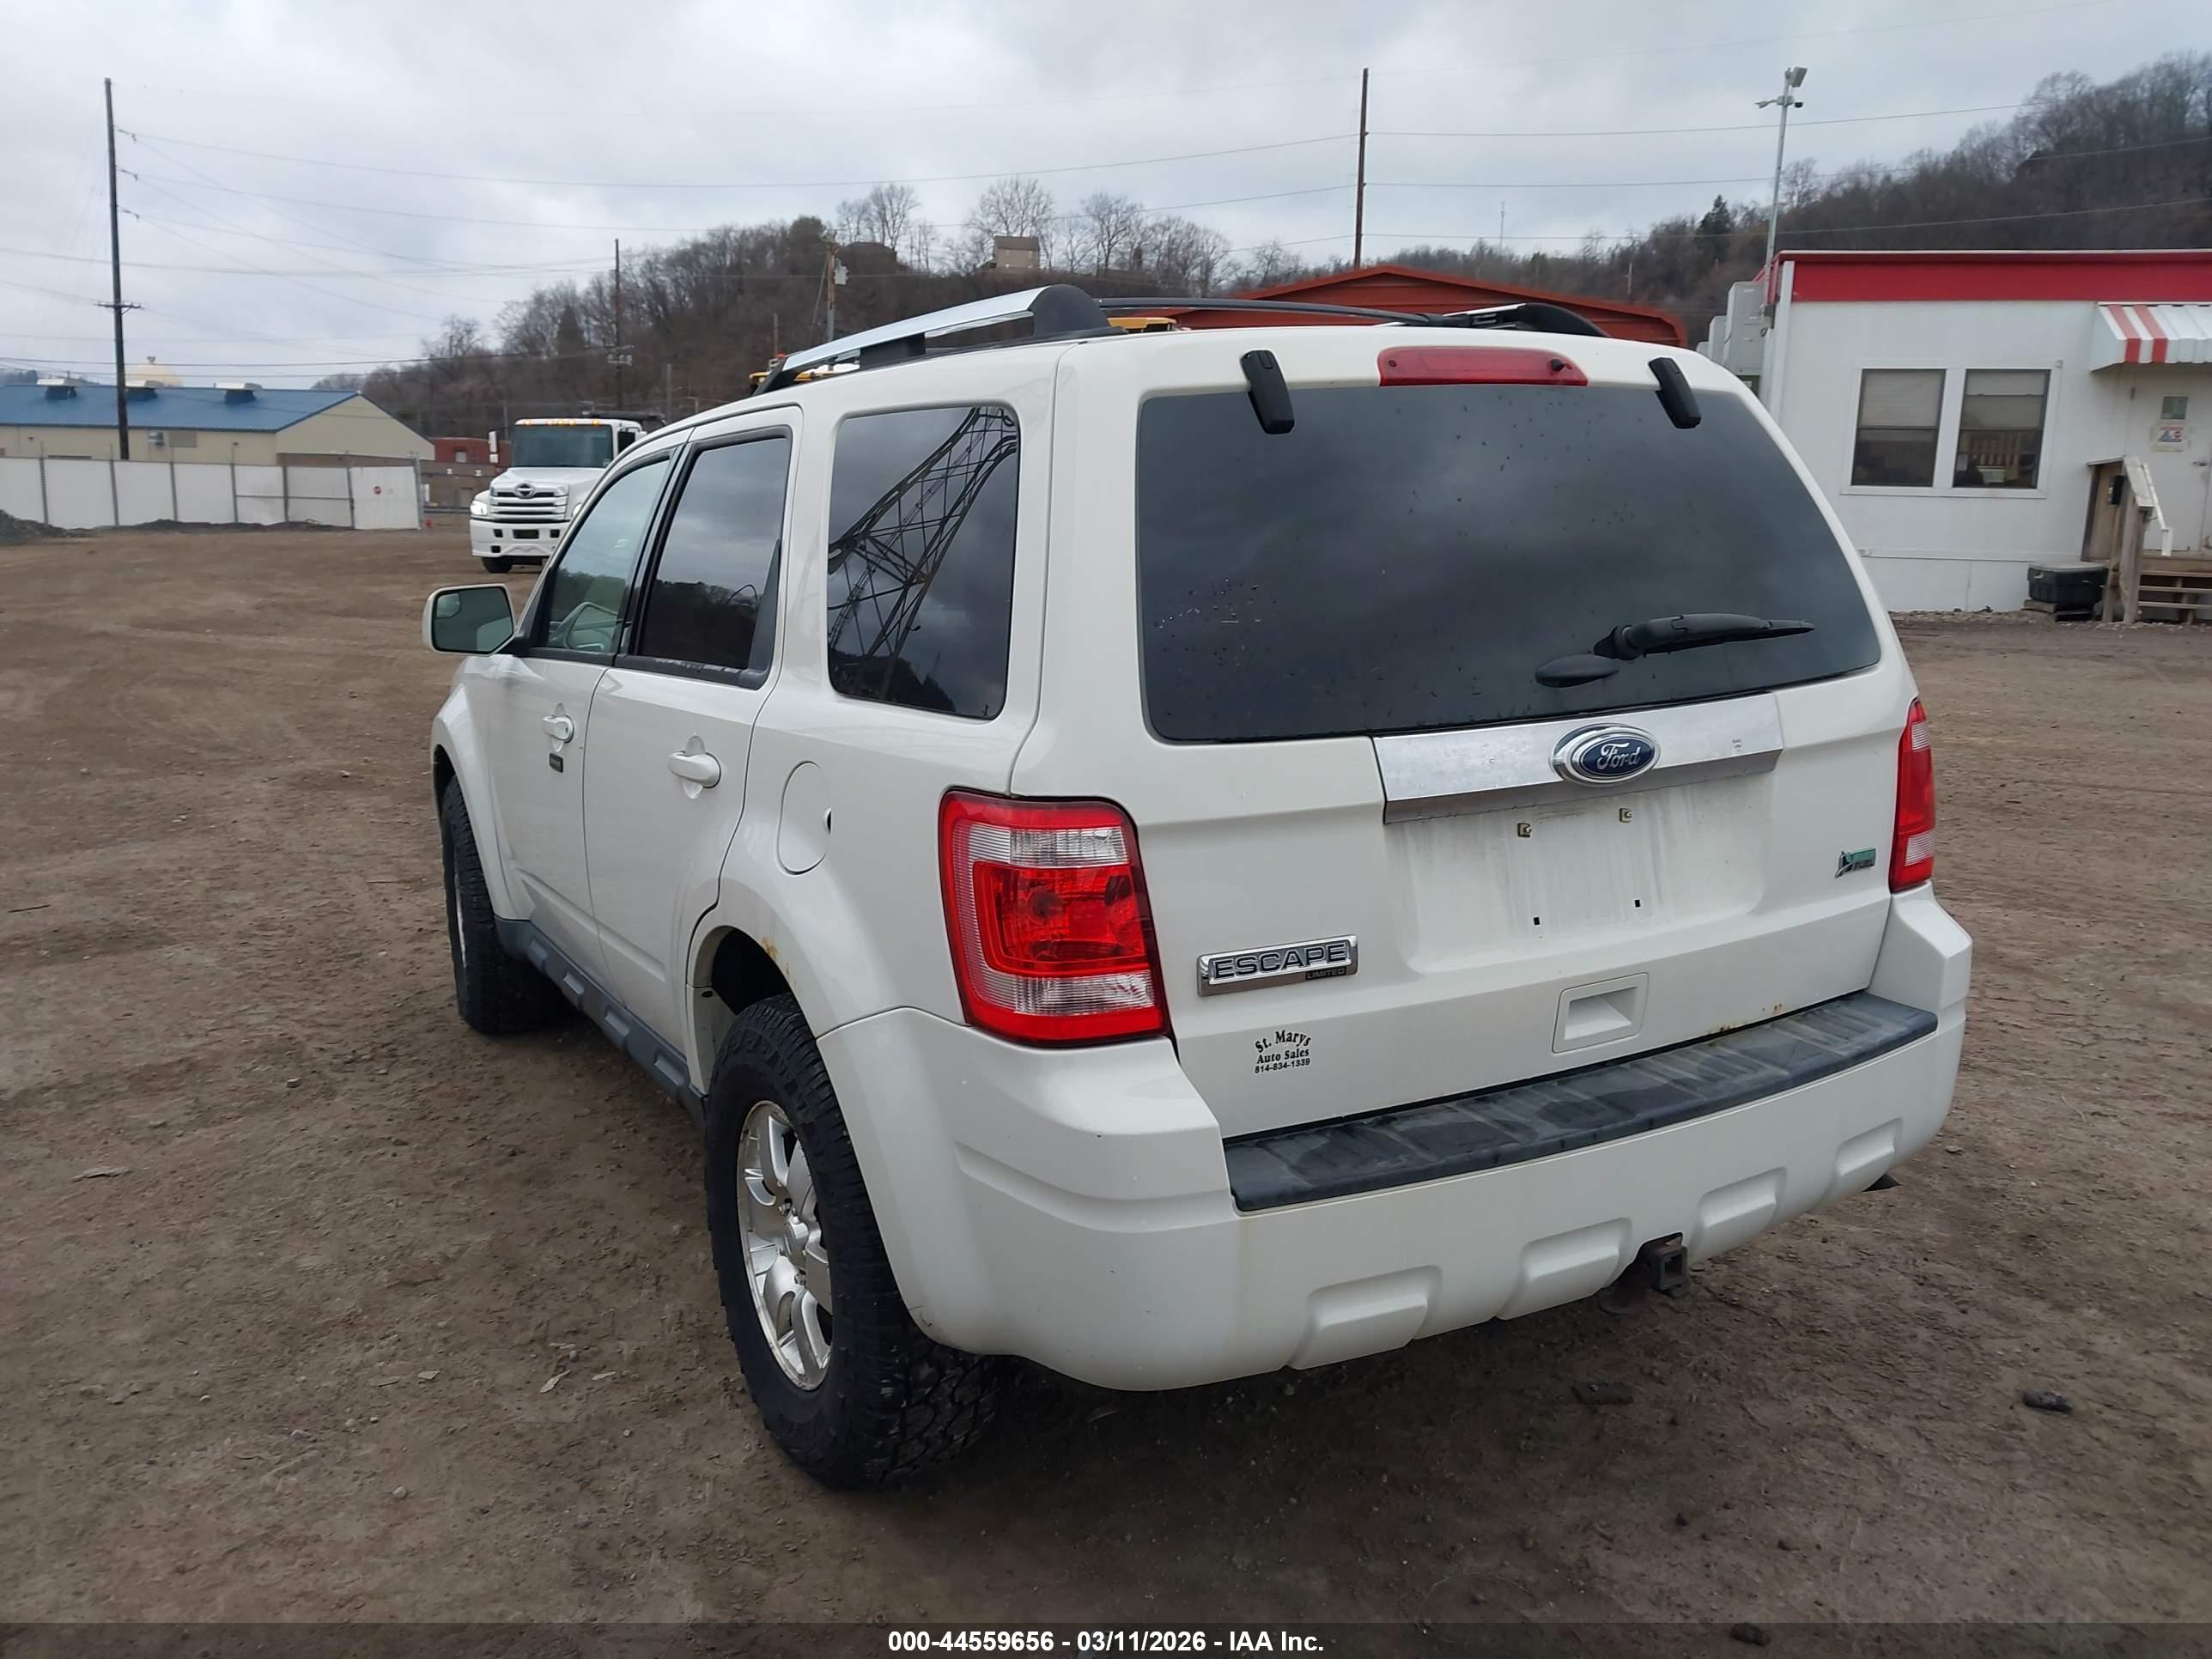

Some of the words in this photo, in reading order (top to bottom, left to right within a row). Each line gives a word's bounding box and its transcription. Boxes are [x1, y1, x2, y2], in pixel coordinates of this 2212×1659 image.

[1597, 742, 1641, 769] Ford
[1213, 942, 1347, 979] ESCAPE
[1306, 968, 1346, 980] LIMITED
[1255, 1038, 1272, 1053] St.
[1275, 1030, 1311, 1047] Marys
[1255, 1058, 1310, 1073] 814-834-1339
[1257, 1054, 1281, 1064] Auto
[1285, 1048, 1310, 1060] Sales
